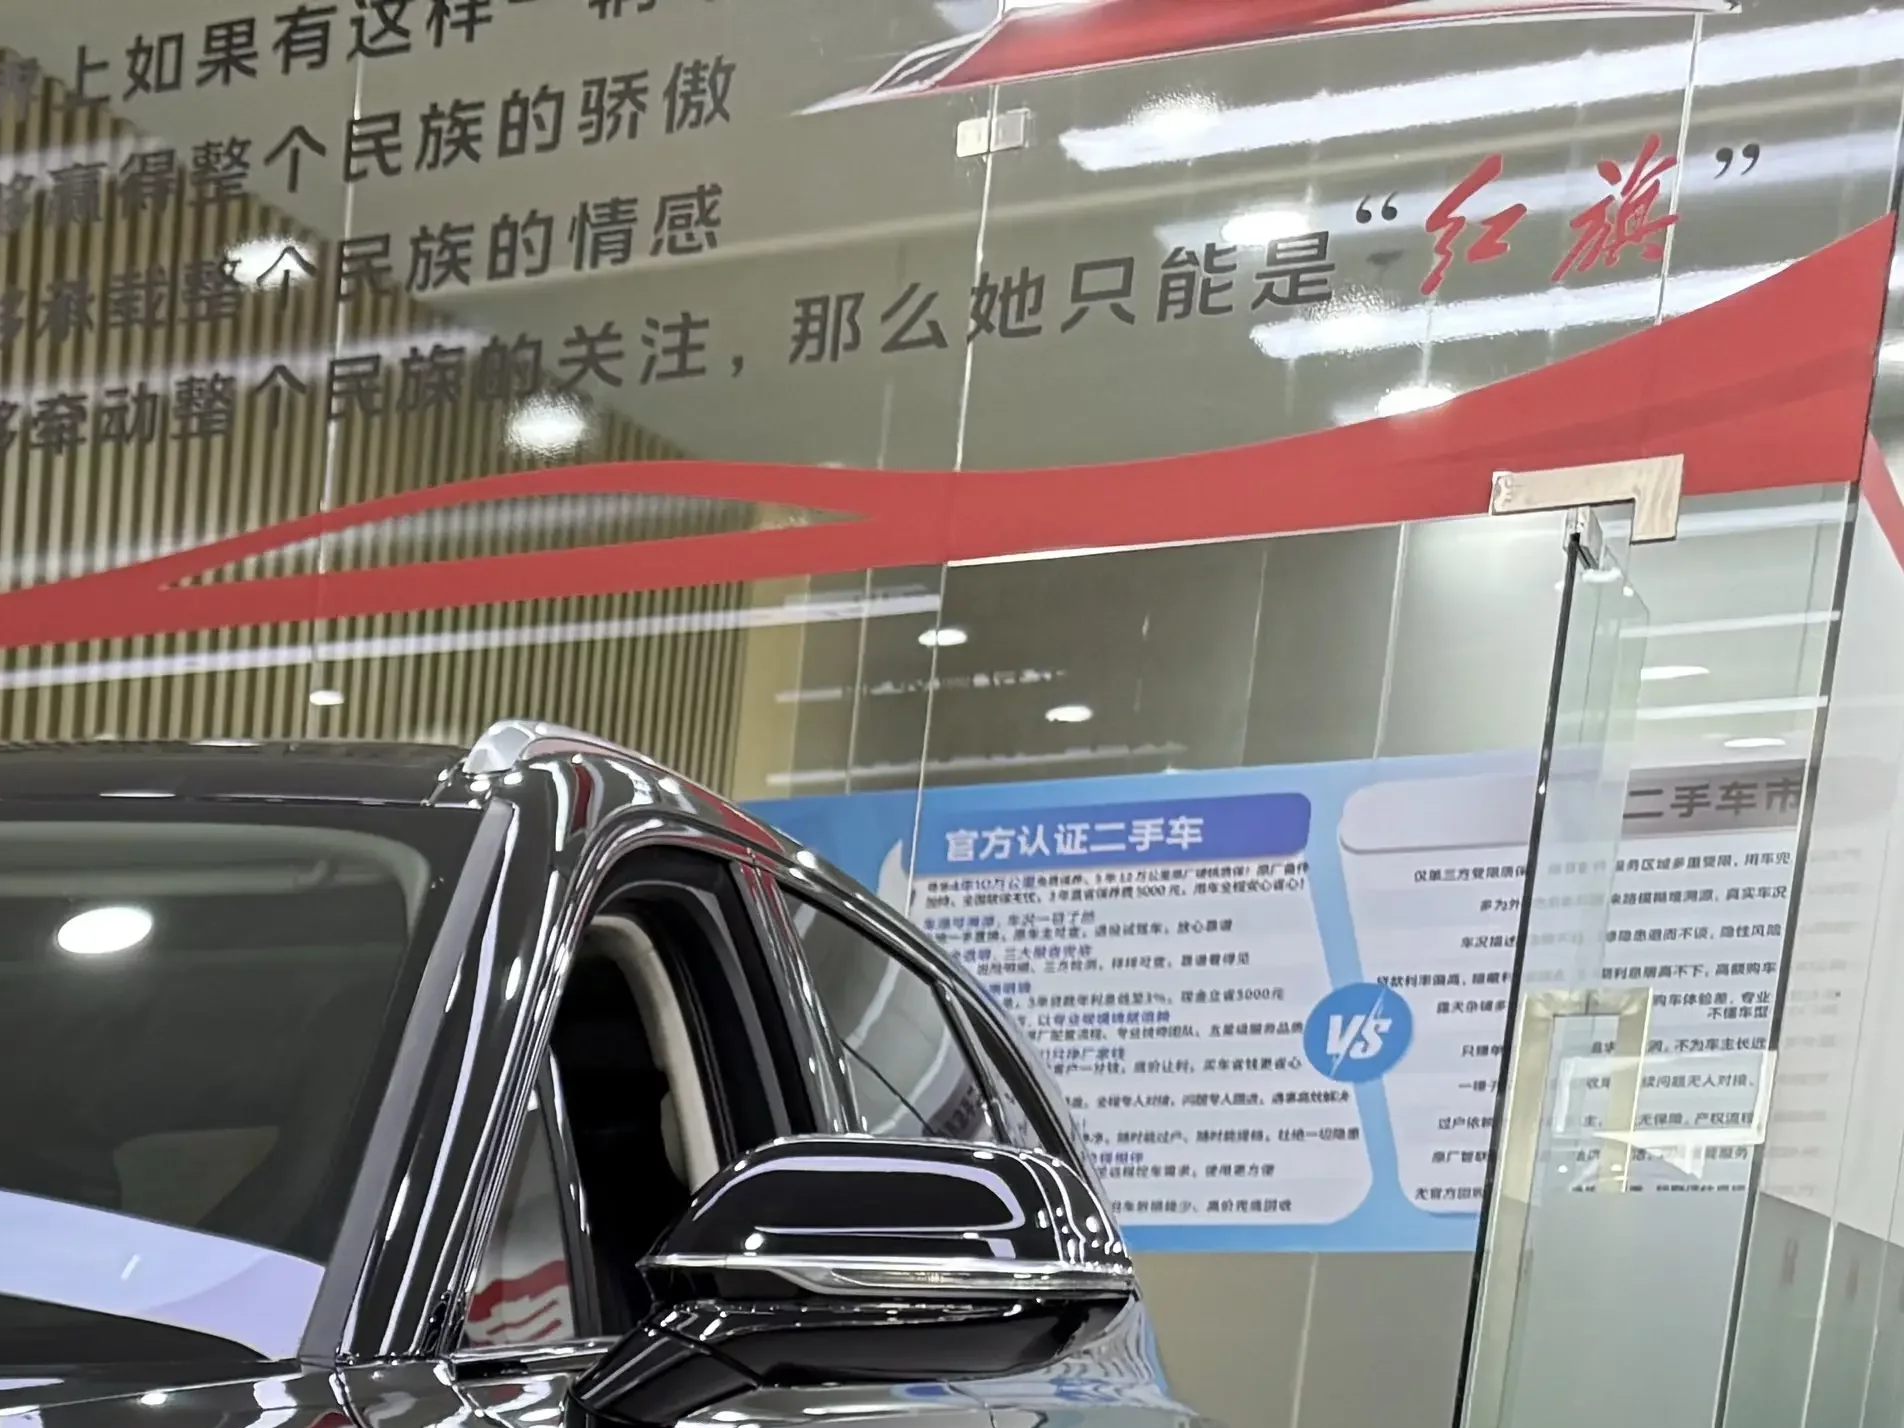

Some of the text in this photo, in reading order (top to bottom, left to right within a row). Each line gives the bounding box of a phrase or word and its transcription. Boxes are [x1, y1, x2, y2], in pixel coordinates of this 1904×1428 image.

[945, 815, 1206, 864] 官方认证二手车
[1325, 1013, 1392, 1062] VS
